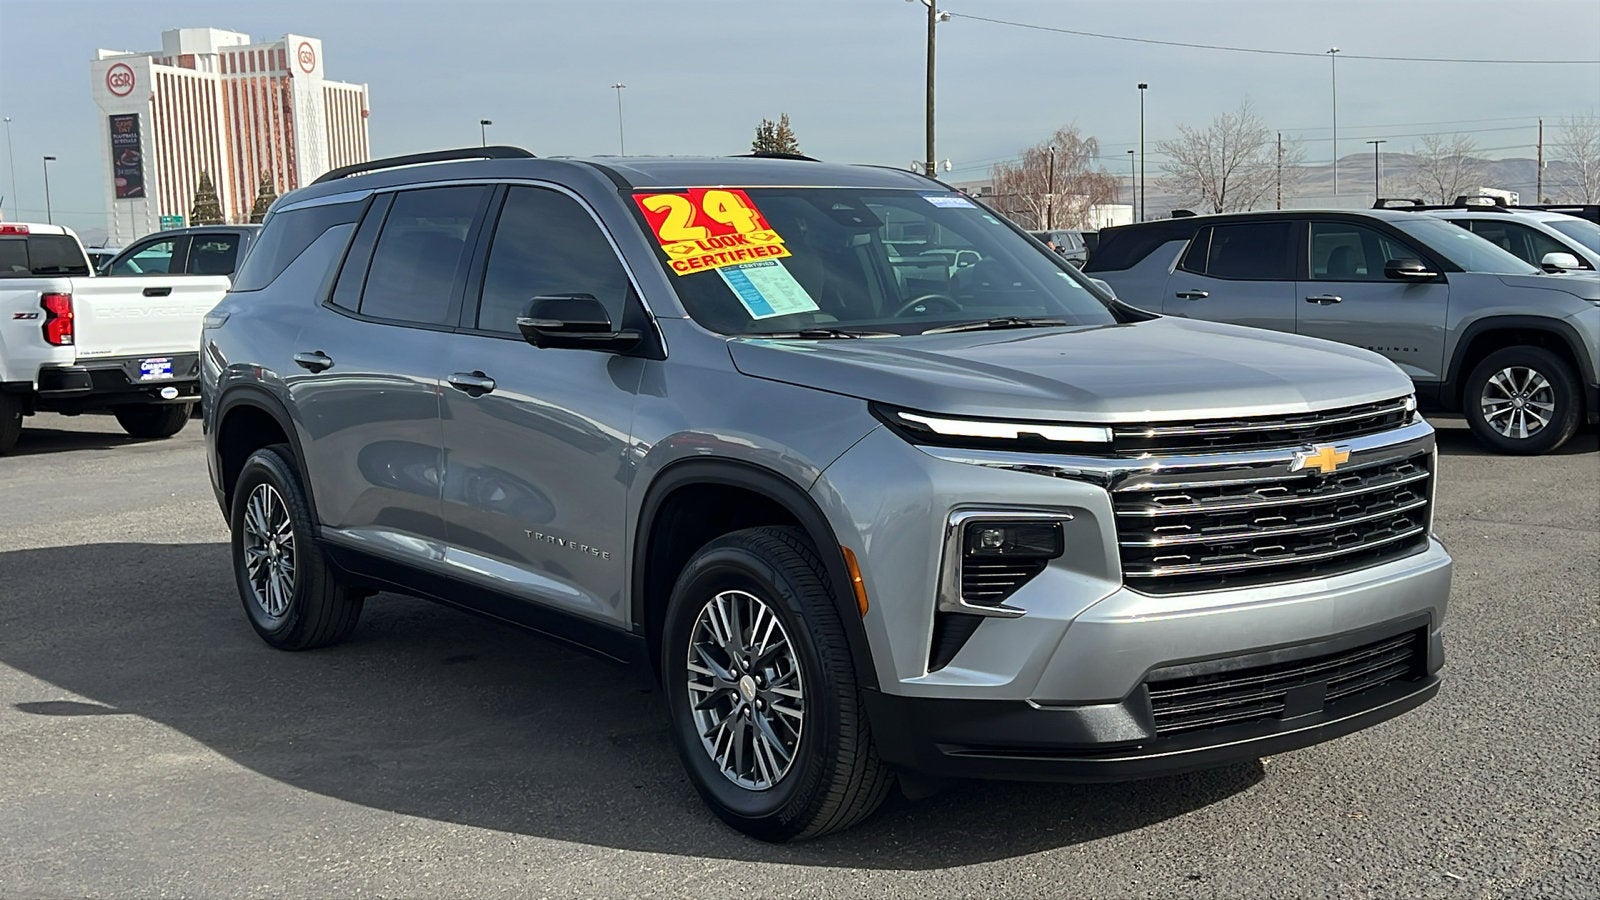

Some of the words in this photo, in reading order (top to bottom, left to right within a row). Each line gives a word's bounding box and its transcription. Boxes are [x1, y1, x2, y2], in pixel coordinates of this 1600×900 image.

[109, 72, 131, 88] GSR
[642, 190, 762, 241] 24
[695, 233, 751, 252] LOOK
[672, 245, 782, 272] CERTIFIED
[738, 261, 775, 269] CERTIFIED
[524, 529, 611, 561] TRAVERSE
